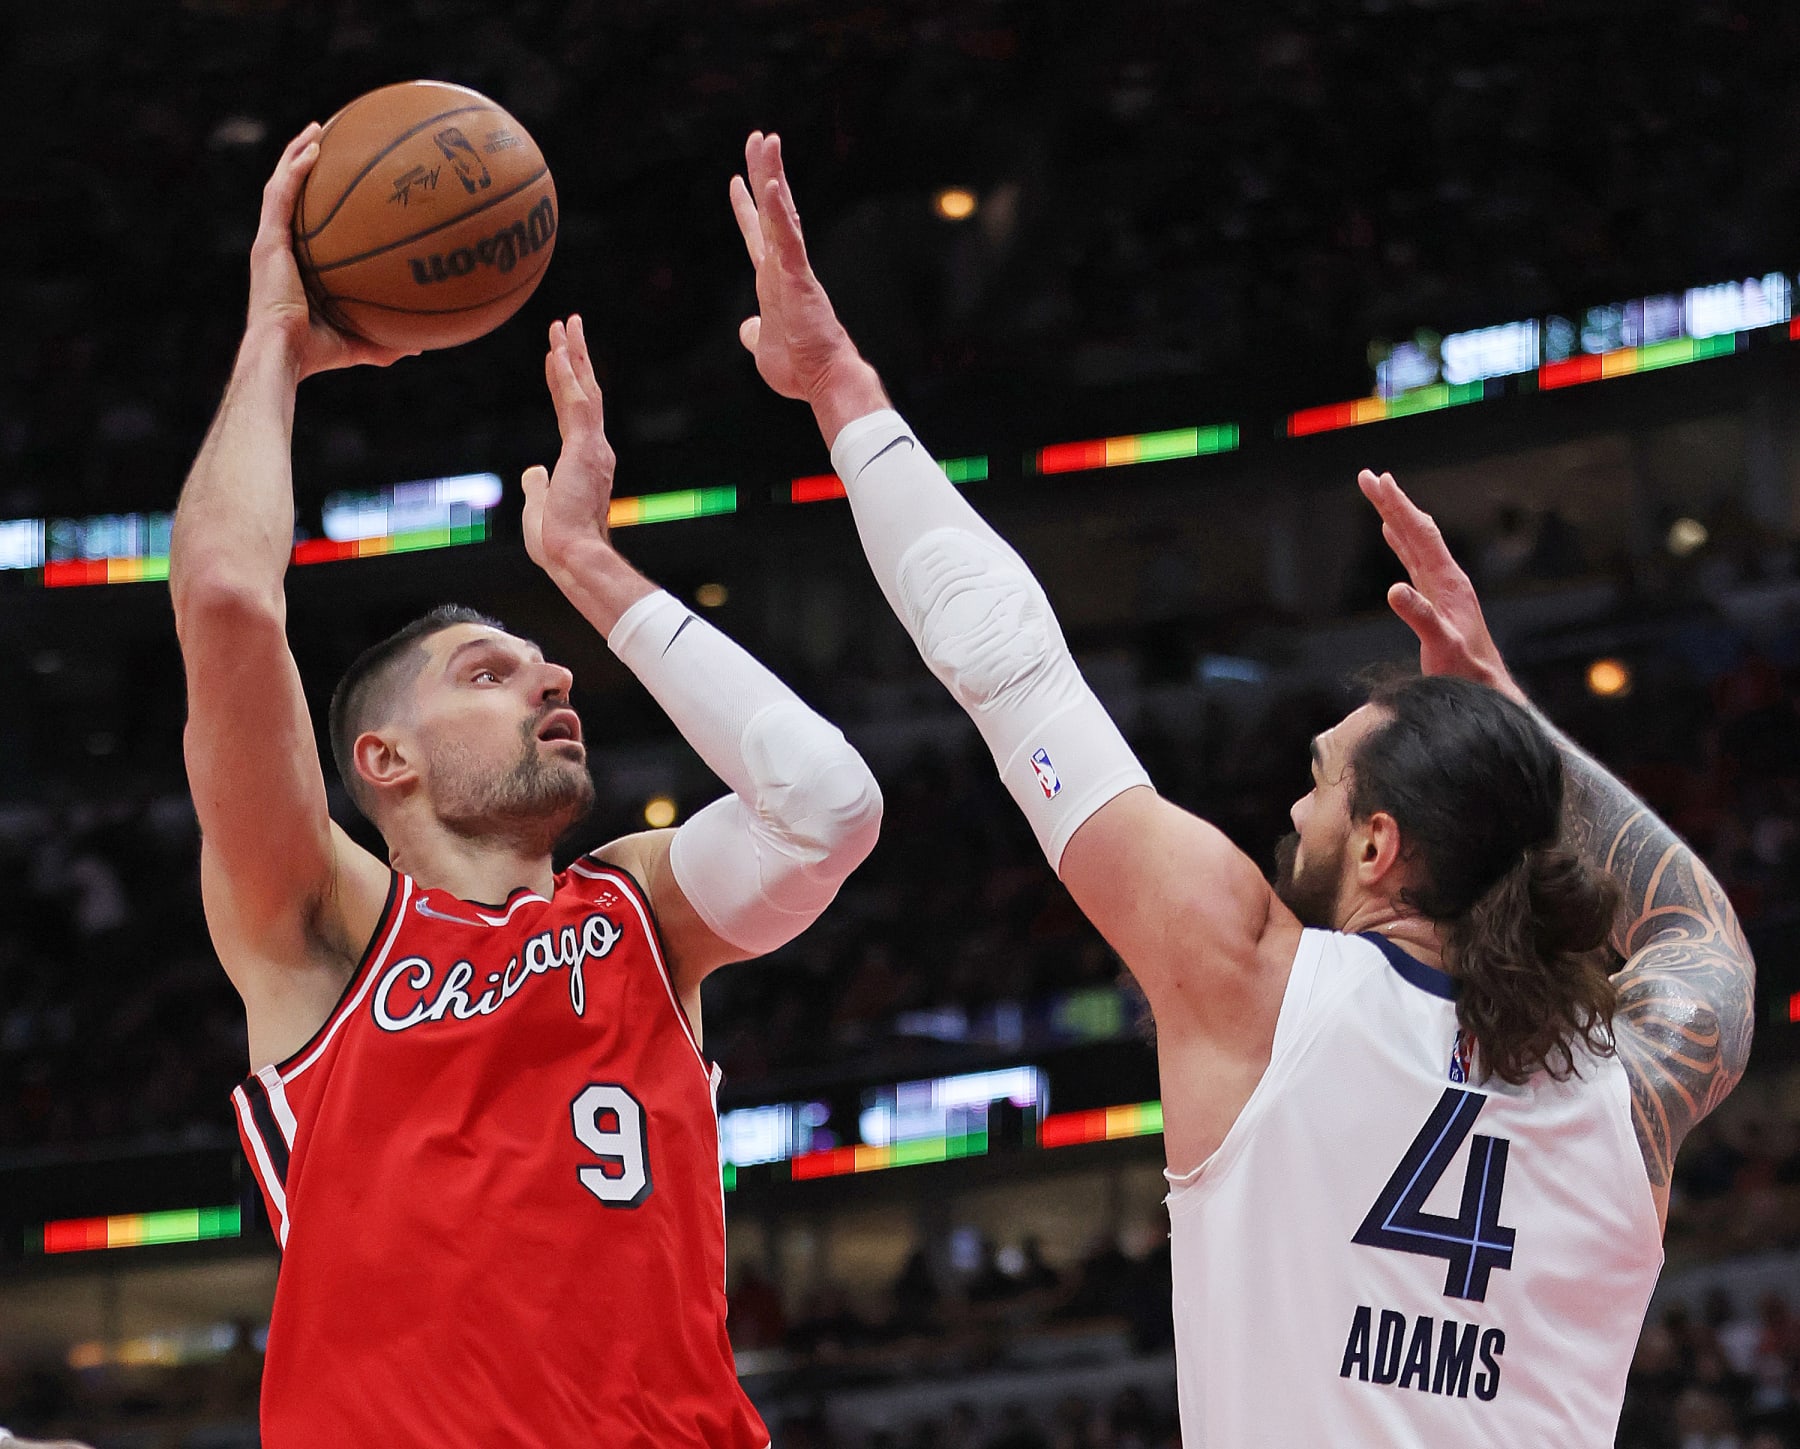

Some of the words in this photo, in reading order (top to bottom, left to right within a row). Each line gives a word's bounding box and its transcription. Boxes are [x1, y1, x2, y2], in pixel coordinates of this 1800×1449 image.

[410, 196, 556, 284] Wilson
[372, 914, 623, 1032] Chicago
[570, 1083, 653, 1208] 9
[1351, 1087, 1516, 1302] 4
[1340, 1306, 1506, 1401] ADAMS
